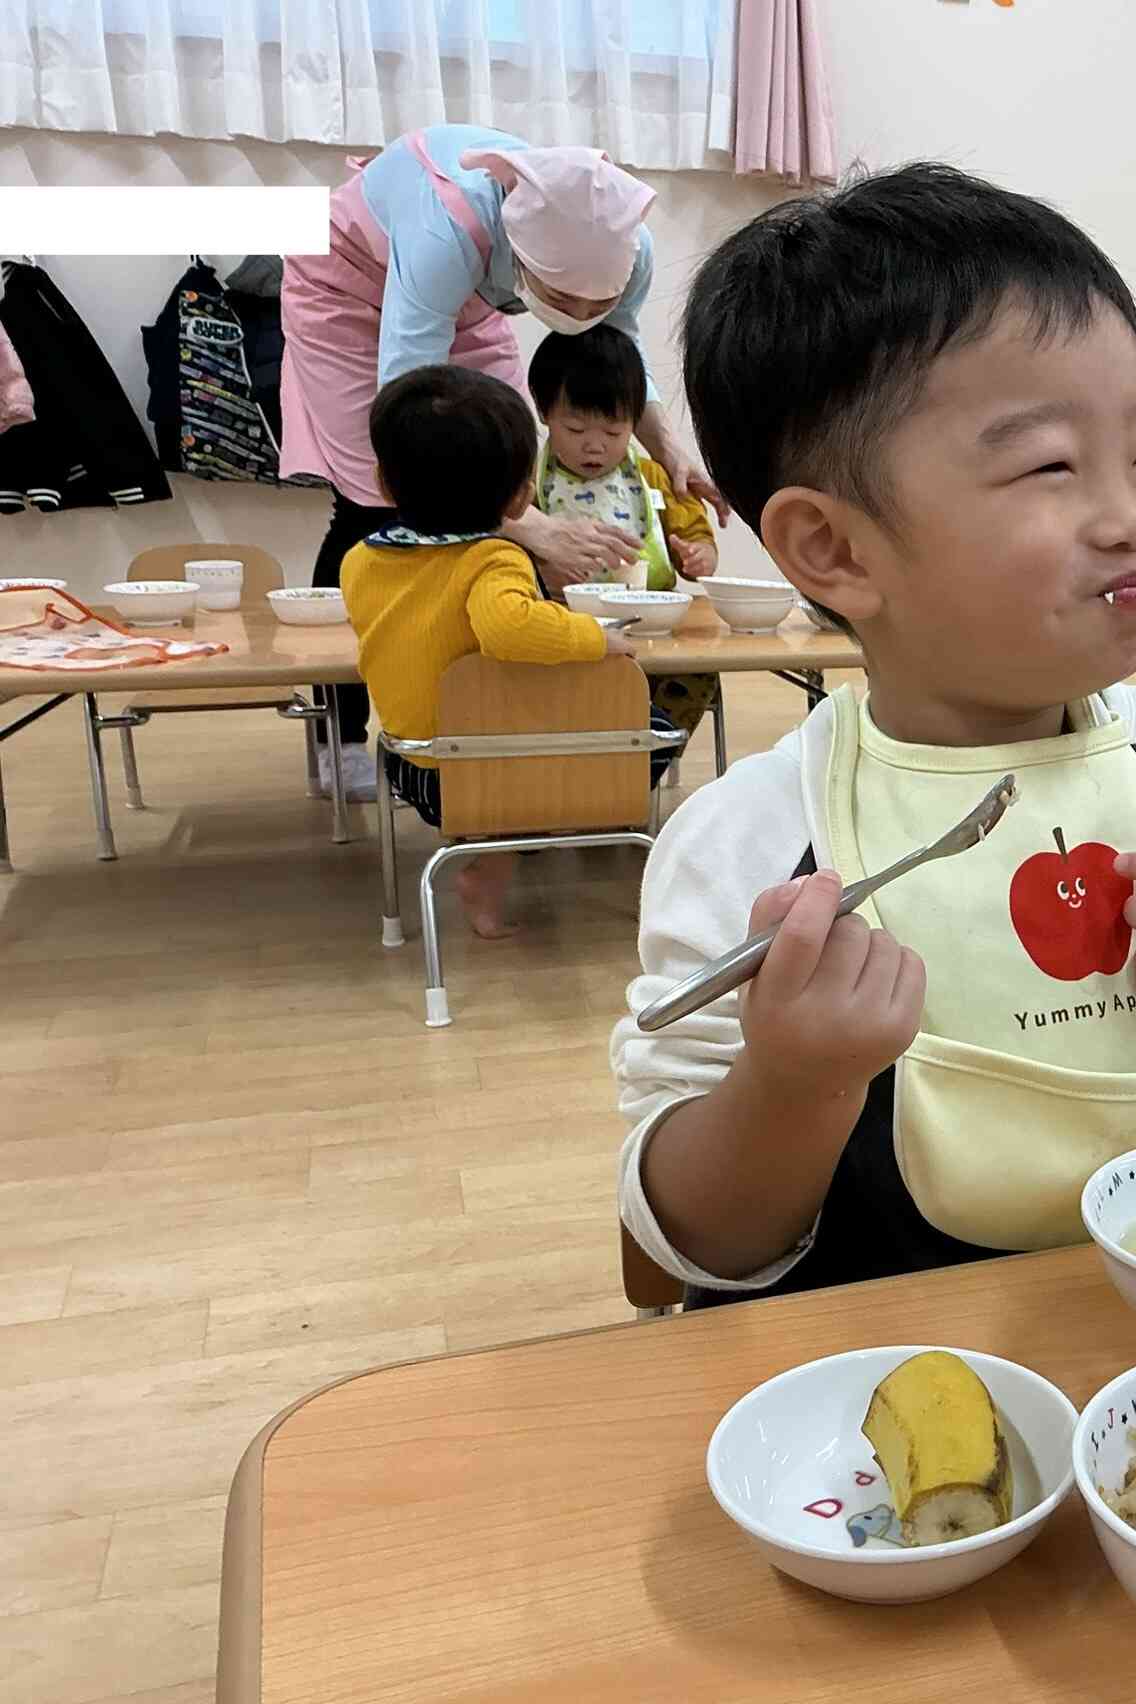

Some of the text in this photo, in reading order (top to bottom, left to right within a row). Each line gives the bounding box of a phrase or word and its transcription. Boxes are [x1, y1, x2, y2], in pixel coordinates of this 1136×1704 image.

[1014, 1000, 1107, 1030] Yummy
[1112, 1172, 1123, 1191] M
[1107, 1408, 1115, 1429] J
